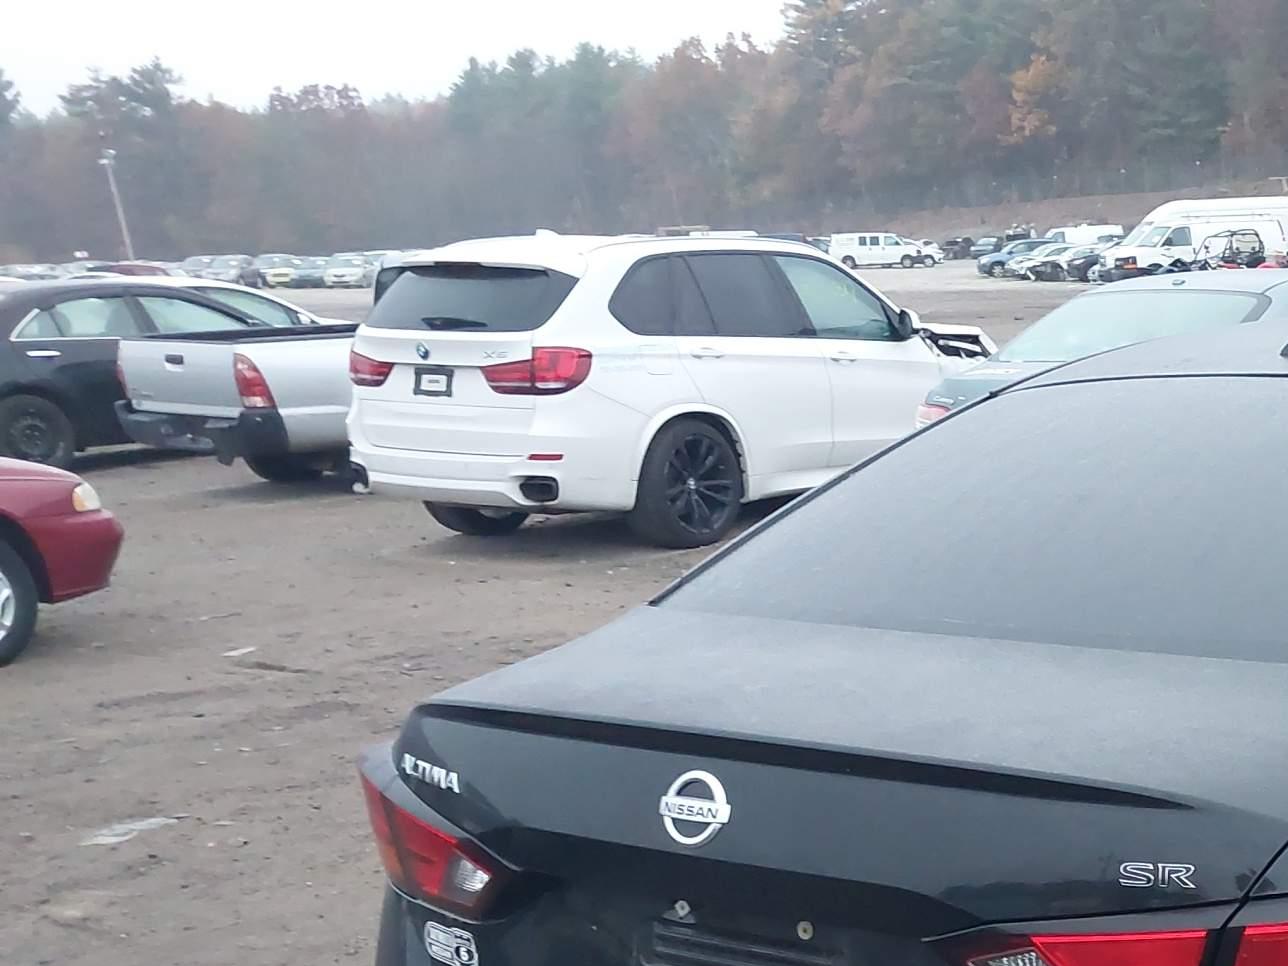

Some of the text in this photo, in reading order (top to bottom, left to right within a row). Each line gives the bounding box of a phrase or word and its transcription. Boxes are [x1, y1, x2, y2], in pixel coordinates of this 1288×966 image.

[401, 752, 461, 793] ALTIMA
[663, 801, 719, 819] NISSAN
[1119, 862, 1198, 889] SR
